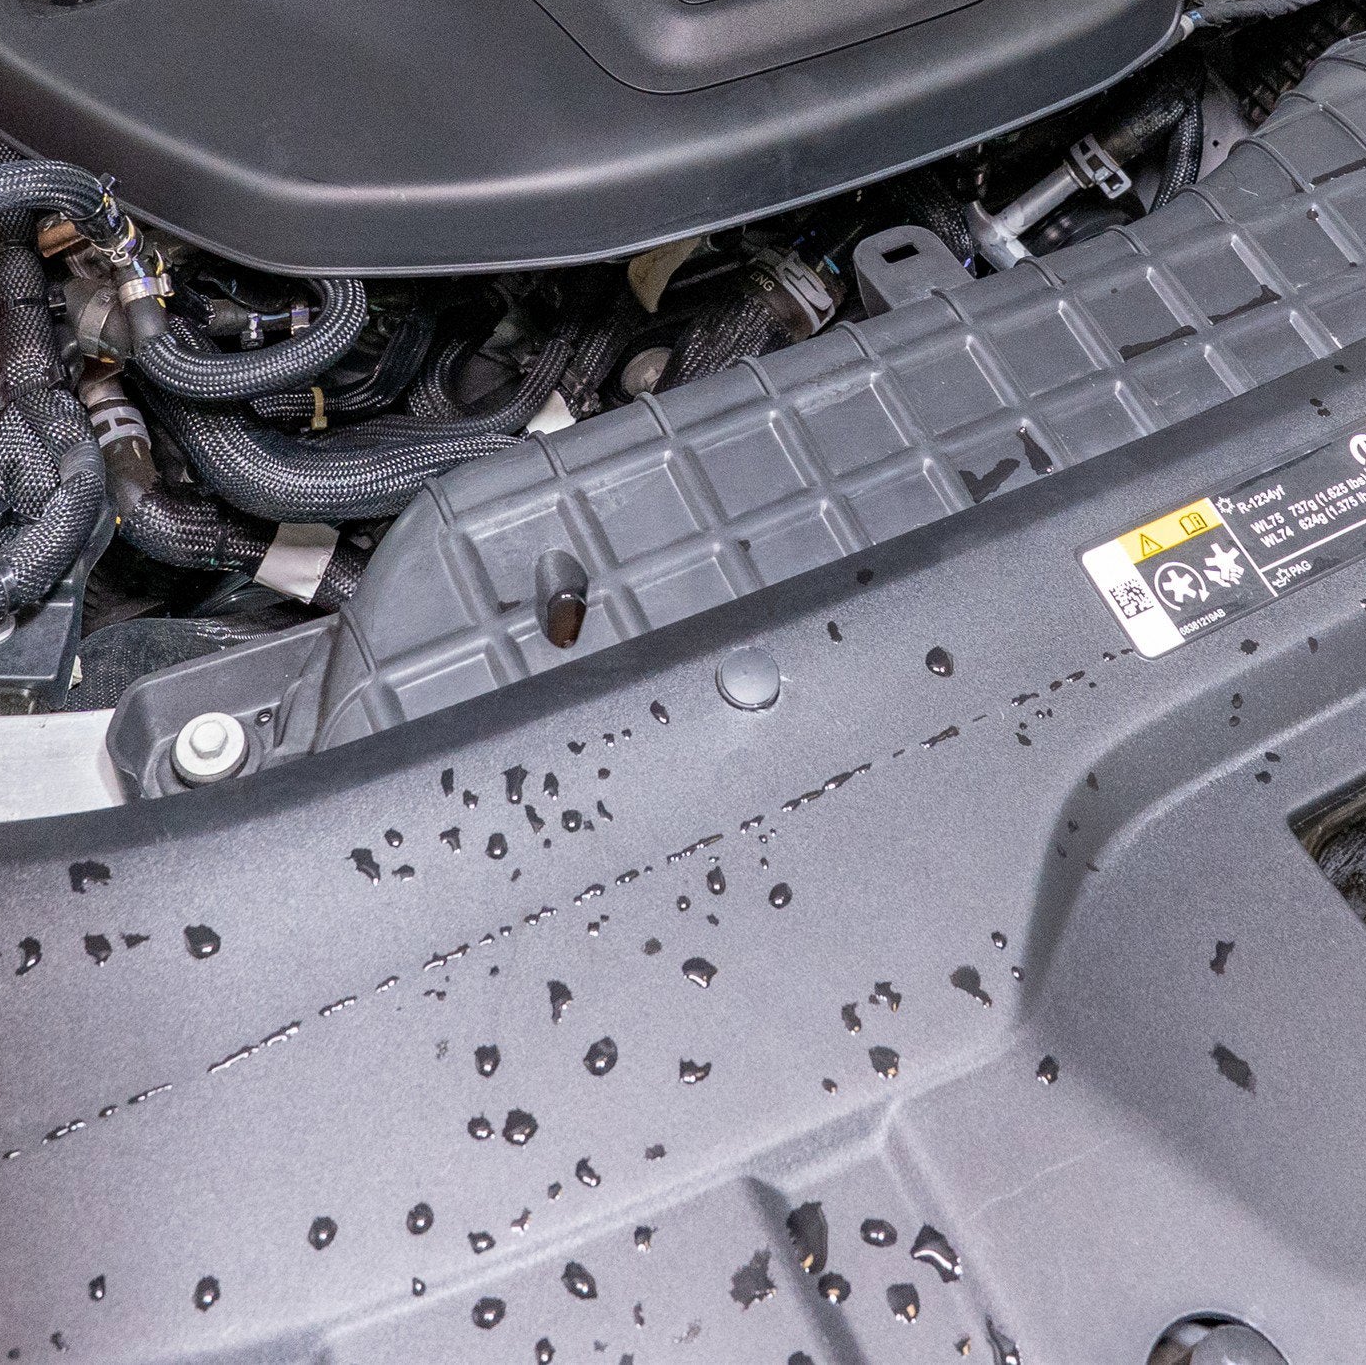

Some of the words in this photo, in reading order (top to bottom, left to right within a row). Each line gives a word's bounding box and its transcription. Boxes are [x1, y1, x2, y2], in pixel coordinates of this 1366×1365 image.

[749, 271, 775, 292] ENG
[1236, 484, 1286, 515] R-1234yf
[1250, 512, 1285, 535] WL75
[1287, 496, 1319, 518] 737g
[1316, 482, 1349, 508] (1.625
[1260, 525, 1295, 548] WL74
[1298, 508, 1329, 531] 624g
[1325, 496, 1359, 520] (1.375
[1290, 560, 1313, 577] PAG
